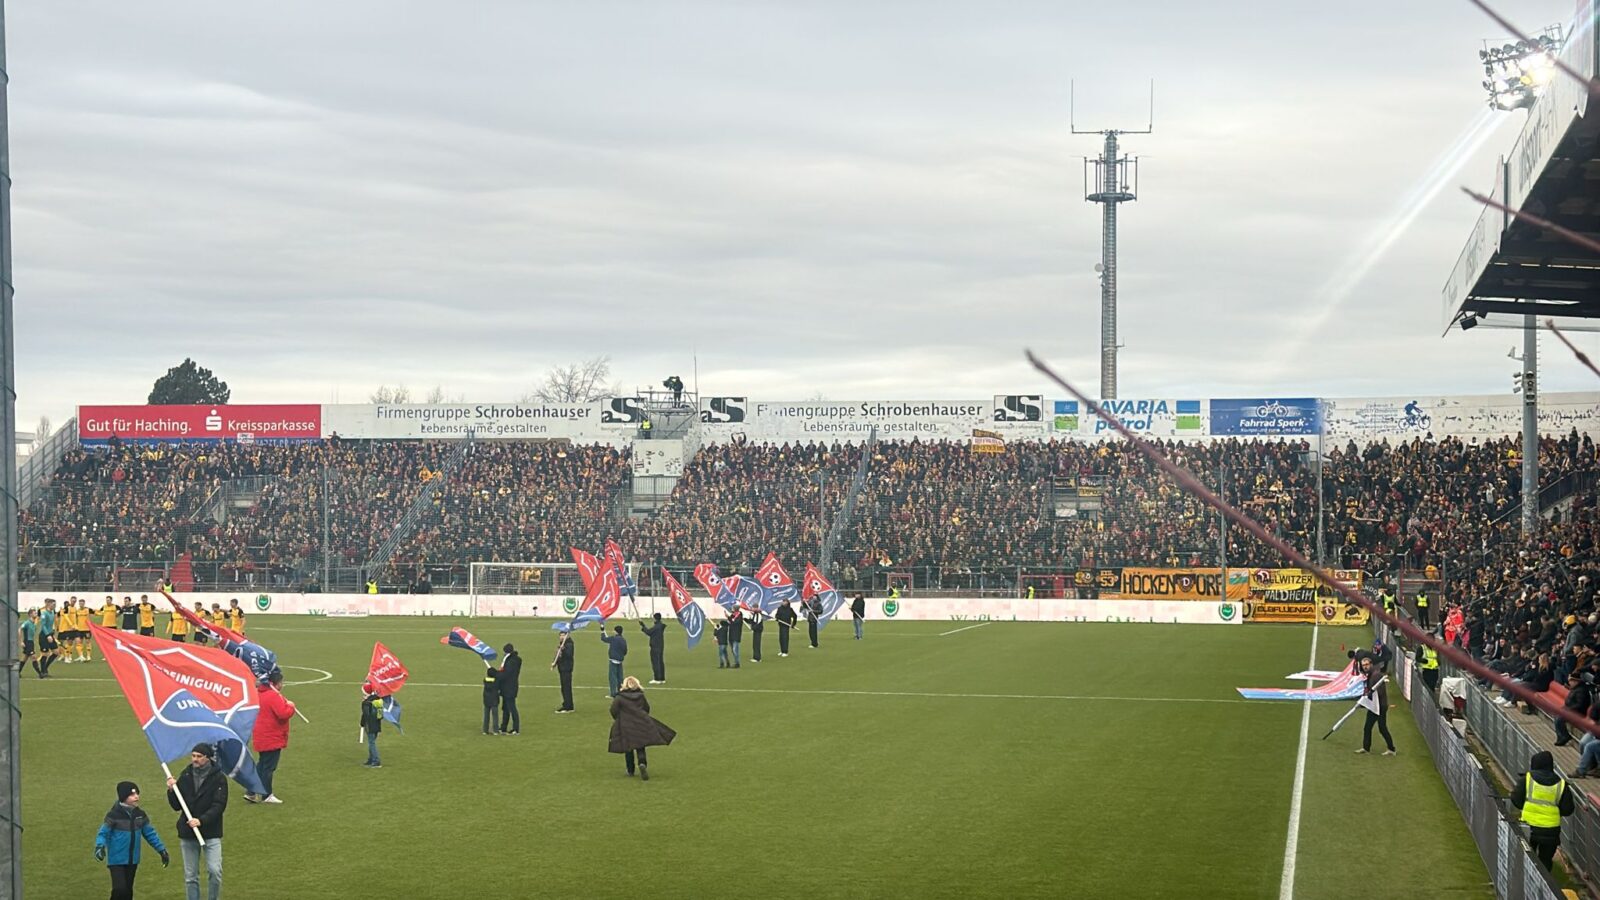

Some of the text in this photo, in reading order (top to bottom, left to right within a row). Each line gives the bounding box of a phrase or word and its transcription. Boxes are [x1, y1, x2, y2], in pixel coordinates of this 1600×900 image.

[377, 404, 591, 420] Firmengruppe Schrobenhauser
[861, 403, 983, 417] Schrobenhauser
[86, 418, 192, 434] Gut für Haching.
[228, 419, 316, 435] Kreissparkasse
[1239, 418, 1304, 428] Fahrrad Sperk
[1264, 589, 1314, 601] WALDHEIM
